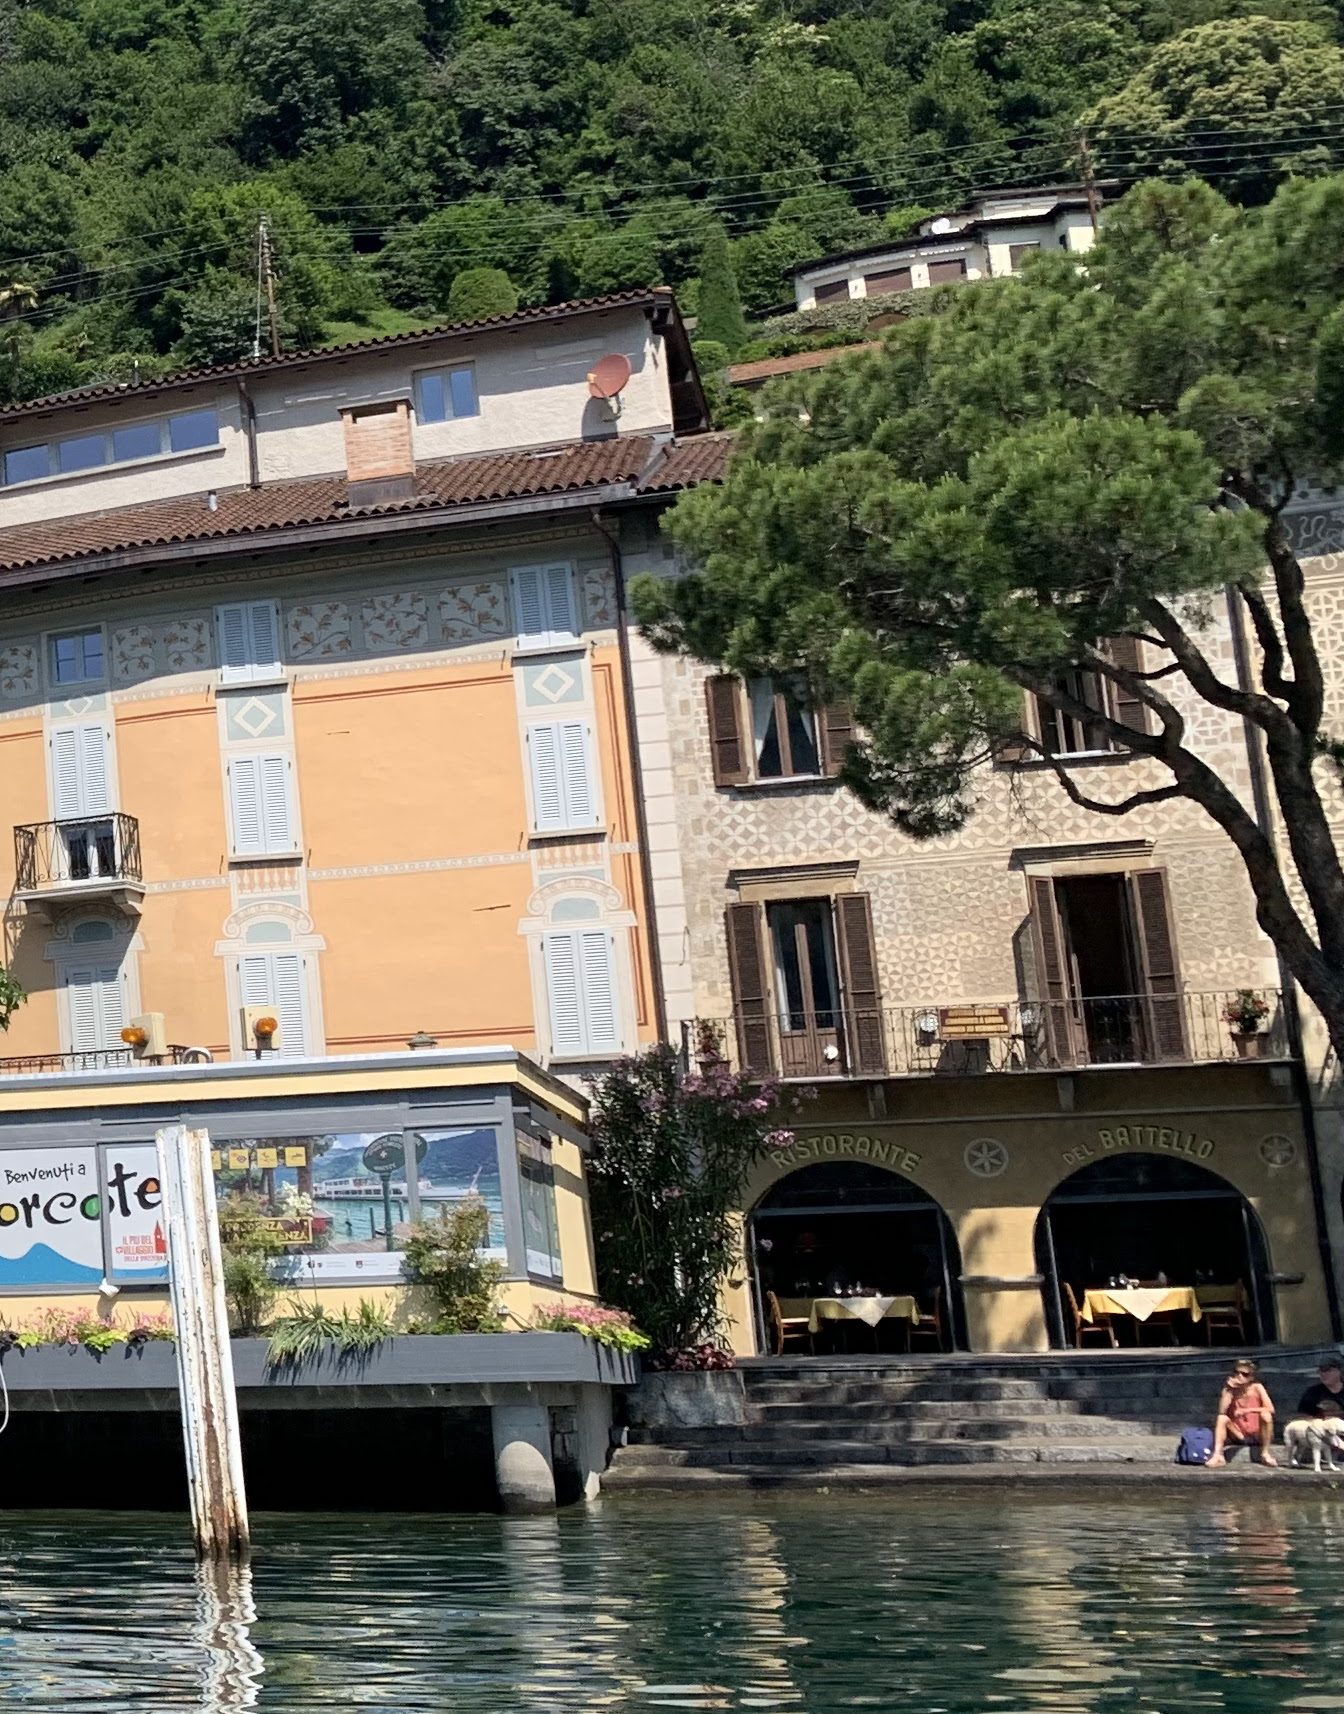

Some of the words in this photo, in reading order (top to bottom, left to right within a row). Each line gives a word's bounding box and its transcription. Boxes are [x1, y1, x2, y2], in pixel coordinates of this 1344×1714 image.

[770, 1135, 922, 1172] RISTORANTE
[1062, 1144, 1094, 1166] DEL
[1098, 1125, 1214, 1159] BATTELLO
[4, 1163, 74, 1185] Benvenuti
[77, 1164, 86, 1176] a
